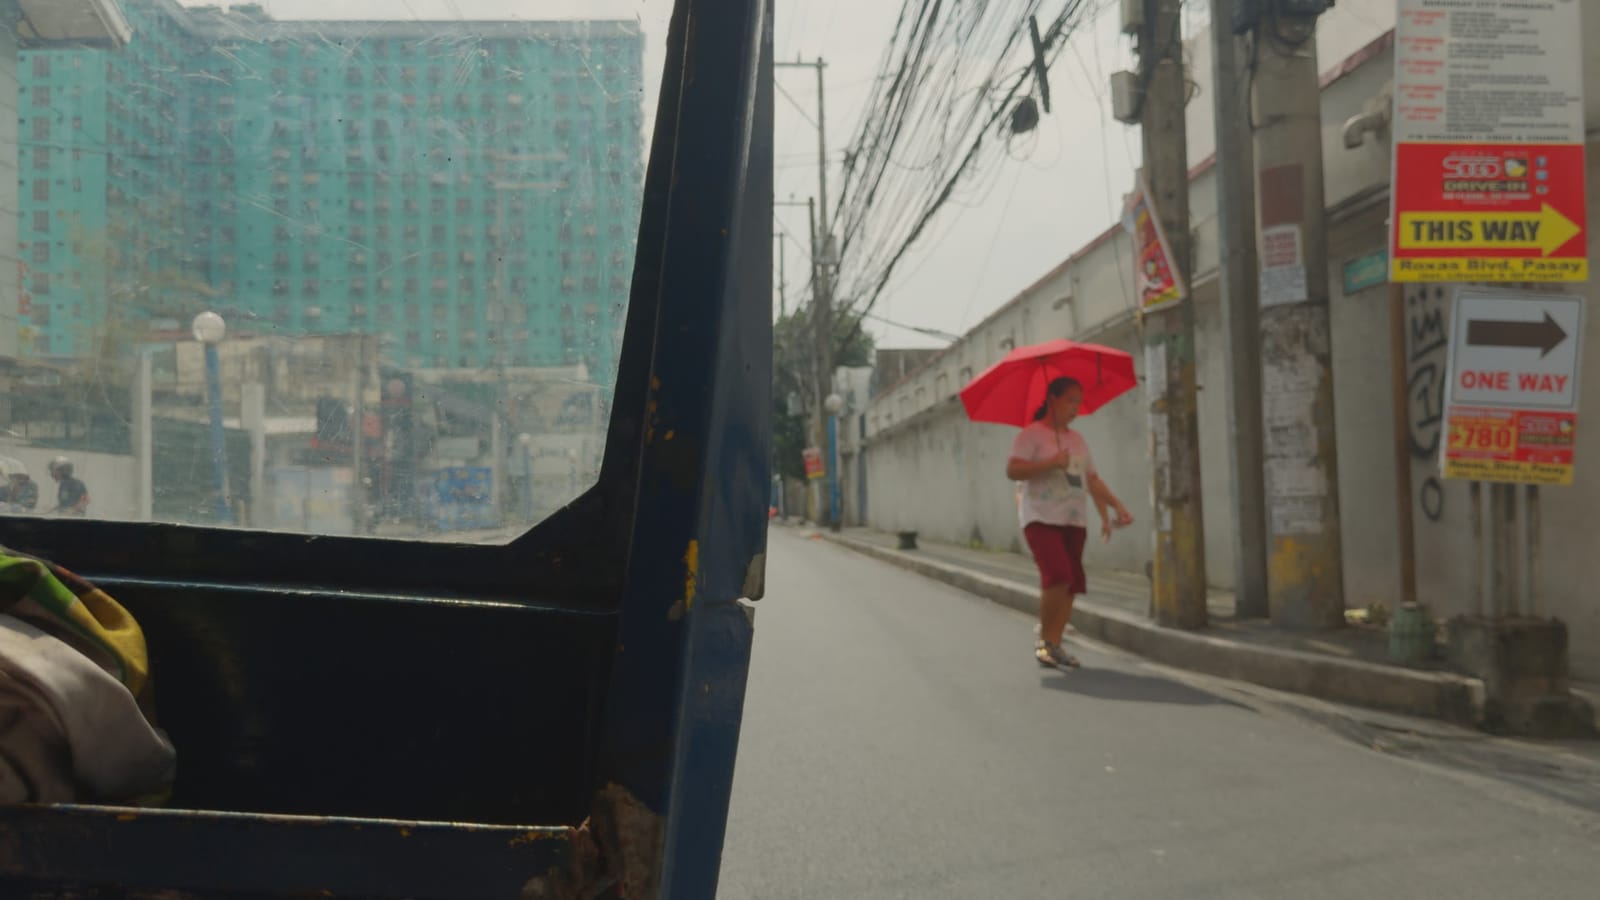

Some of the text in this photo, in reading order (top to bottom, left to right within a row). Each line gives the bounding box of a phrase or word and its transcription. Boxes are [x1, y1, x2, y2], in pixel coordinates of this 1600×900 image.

[1410, 220, 1541, 242] THIS WAY
[1400, 260, 1460, 271] Roxas
[1522, 259, 1581, 273] Pasay
[1460, 370, 1568, 393] ONE WAY
